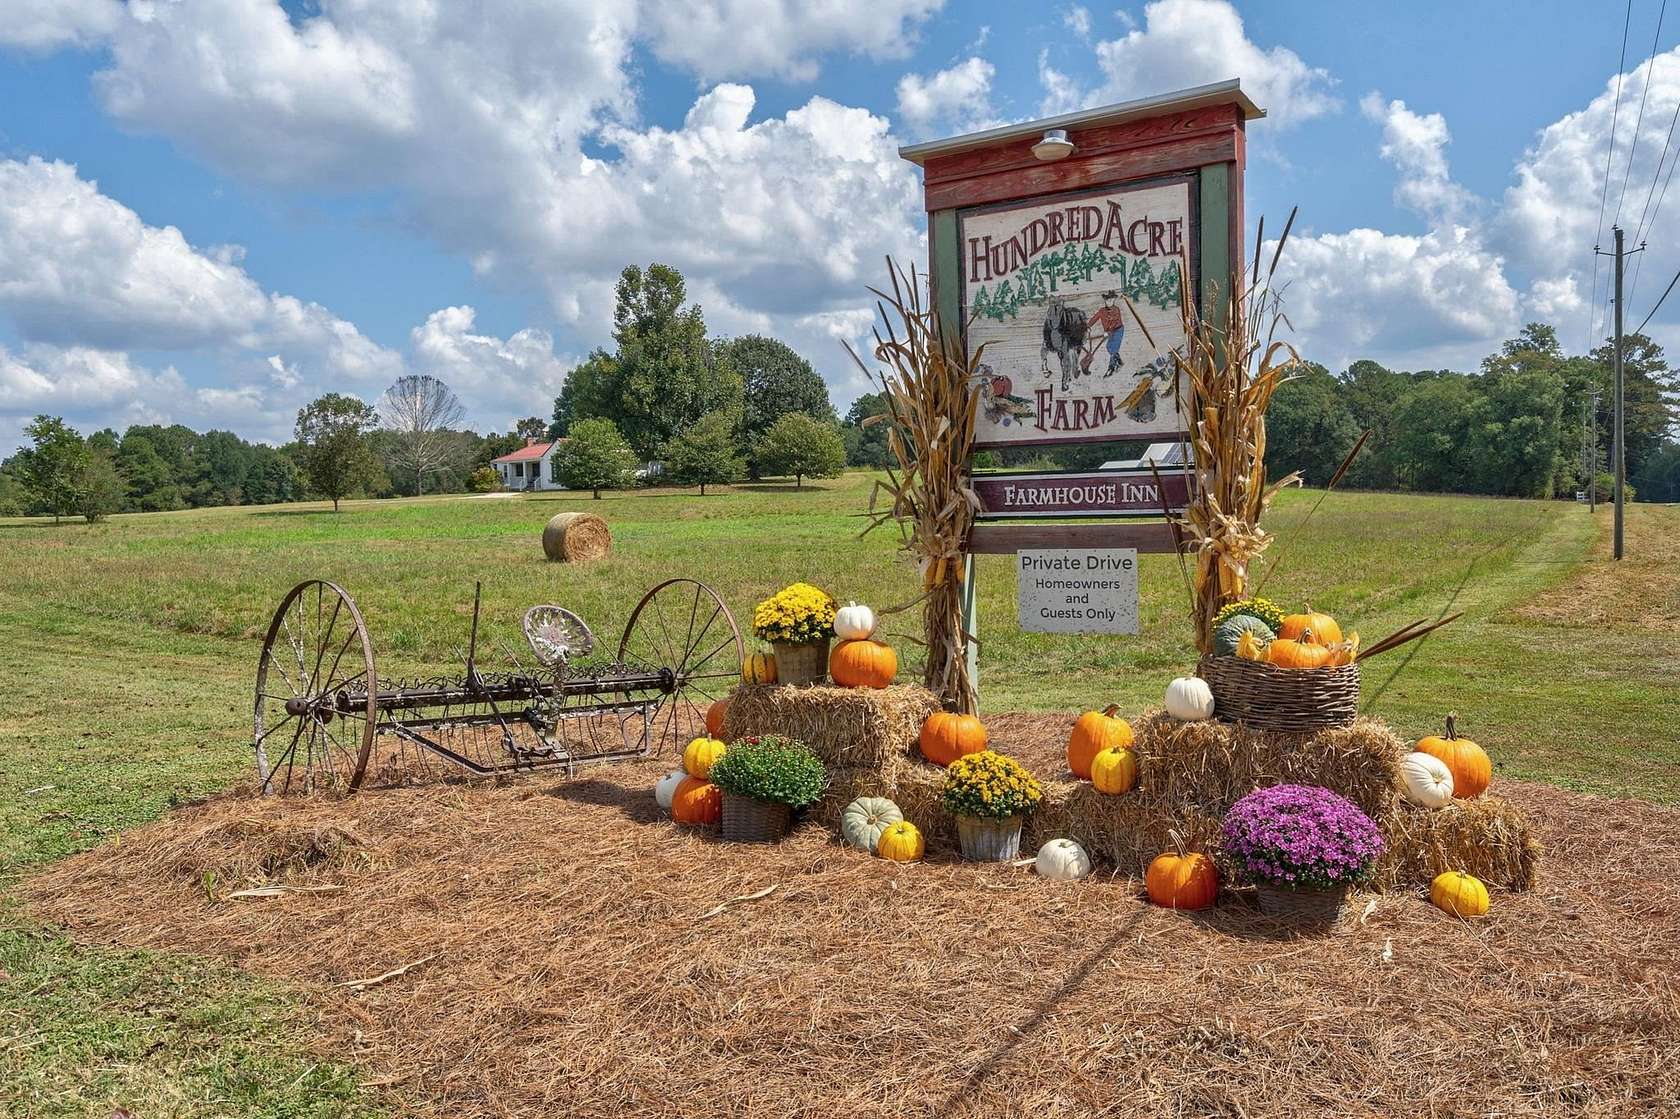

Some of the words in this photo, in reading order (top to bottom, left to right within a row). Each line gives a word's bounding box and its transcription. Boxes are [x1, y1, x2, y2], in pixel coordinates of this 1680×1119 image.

[968, 206, 1104, 282] HUNDRED
[1098, 199, 1183, 258] ACRE
[1033, 384, 1117, 432] FARM
[1004, 483, 1116, 506] FARMHOUSE
[1121, 482, 1159, 504] INN
[1021, 555, 1081, 570] Private
[1086, 554, 1133, 570] Drive
[1035, 578, 1121, 590] Homeowners
[1065, 593, 1089, 604] and
[1040, 607, 1082, 619] Guests
[1086, 607, 1116, 622] Only
